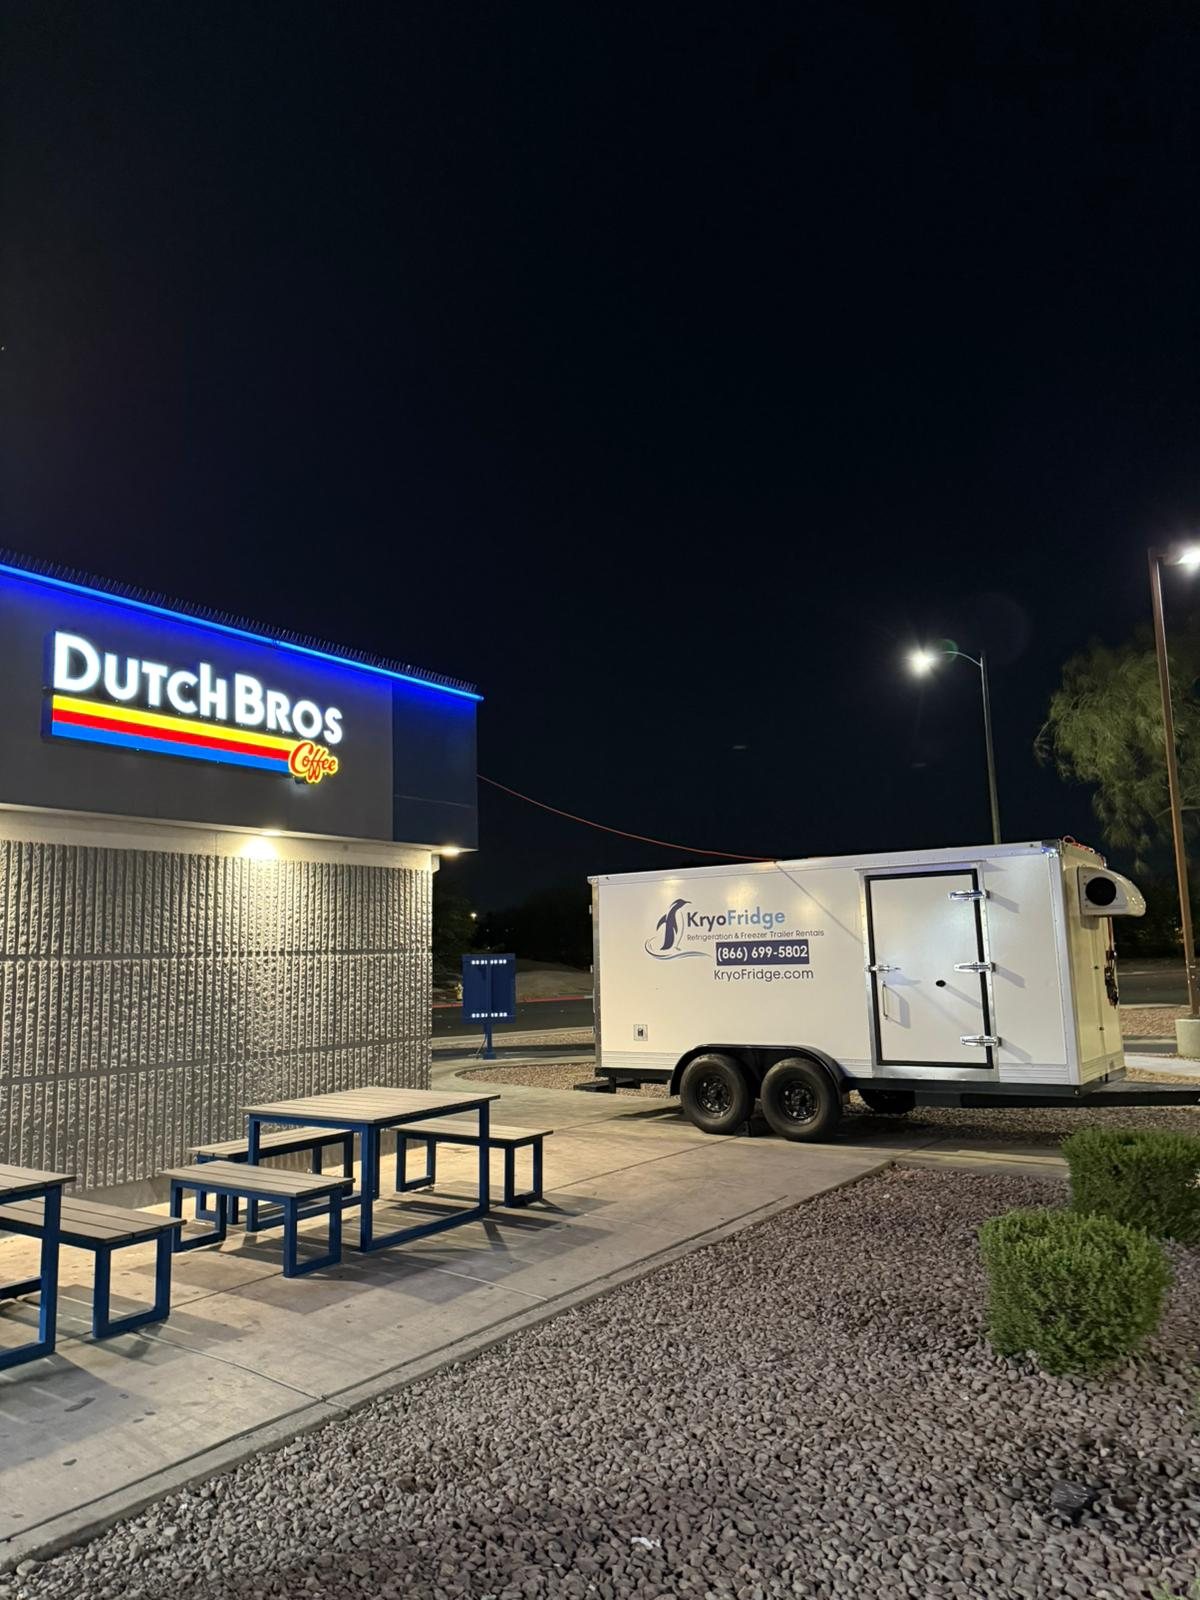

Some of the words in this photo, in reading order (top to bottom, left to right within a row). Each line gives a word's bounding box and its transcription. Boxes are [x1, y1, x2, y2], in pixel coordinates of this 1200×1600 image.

[234, 671, 343, 745] BROS
[288, 740, 338, 784] Coffee
[687, 906, 786, 932] KryoFridge
[687, 933, 733, 943] Refrigeration
[740, 931, 768, 939] Freezer
[770, 930, 794, 938] Trailer
[795, 928, 825, 937] Rentals
[717, 946, 748, 962] (866)
[751, 945, 808, 959] 699-5802
[714, 968, 814, 982] KryoFridge.com
